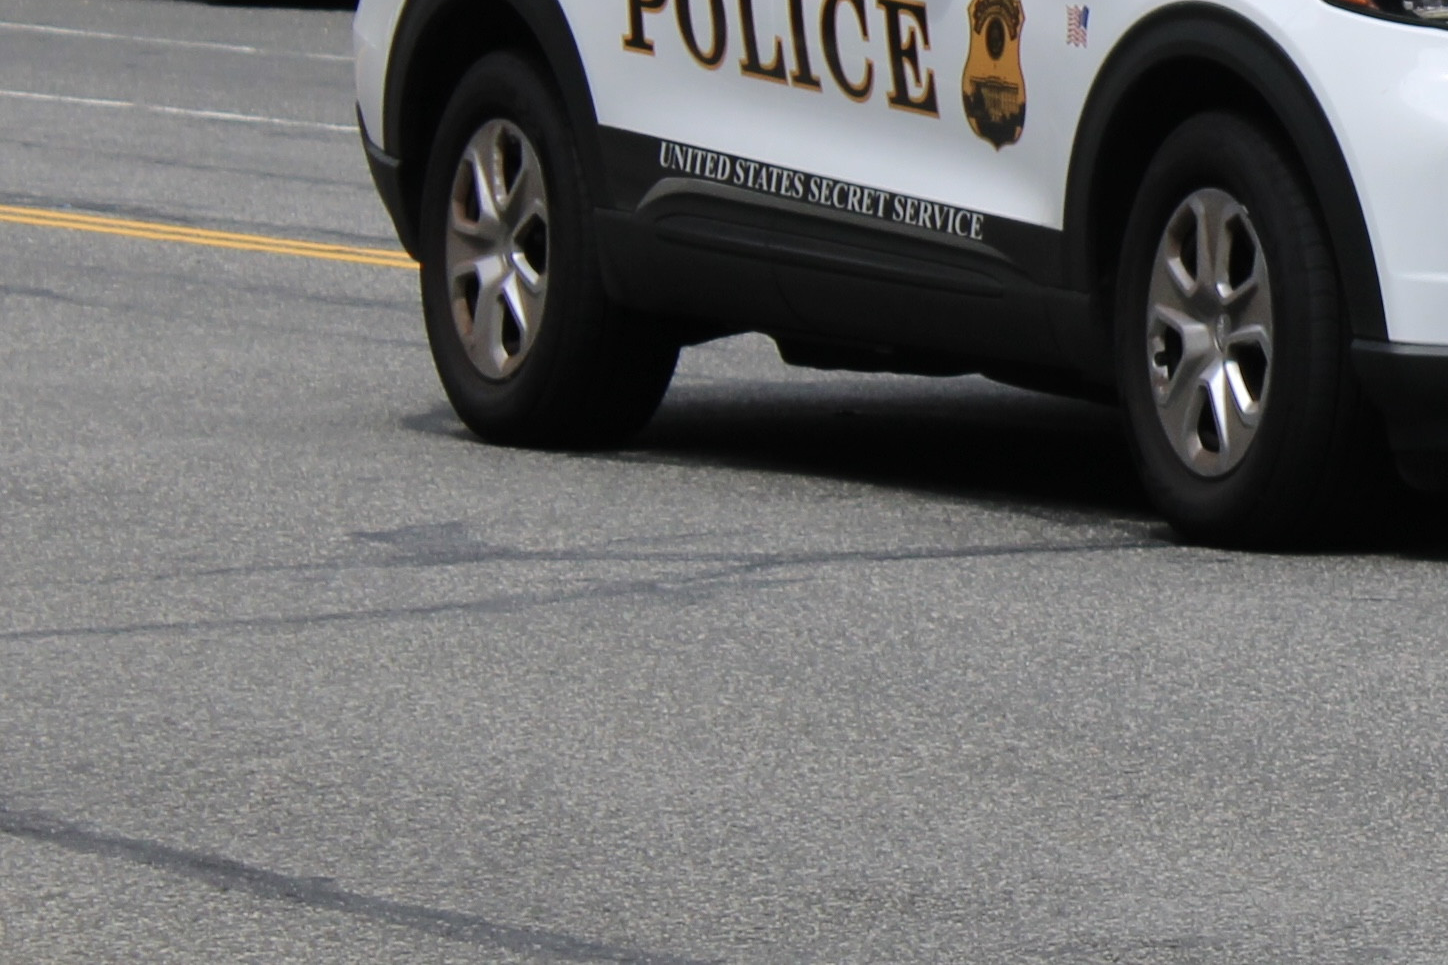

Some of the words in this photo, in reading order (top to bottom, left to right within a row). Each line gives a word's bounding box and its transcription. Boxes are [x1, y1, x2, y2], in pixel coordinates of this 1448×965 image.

[659, 140, 731, 181] UNITED
[733, 159, 804, 199] STATES
[808, 176, 890, 217] SECRET
[892, 195, 985, 240] SERVICE
